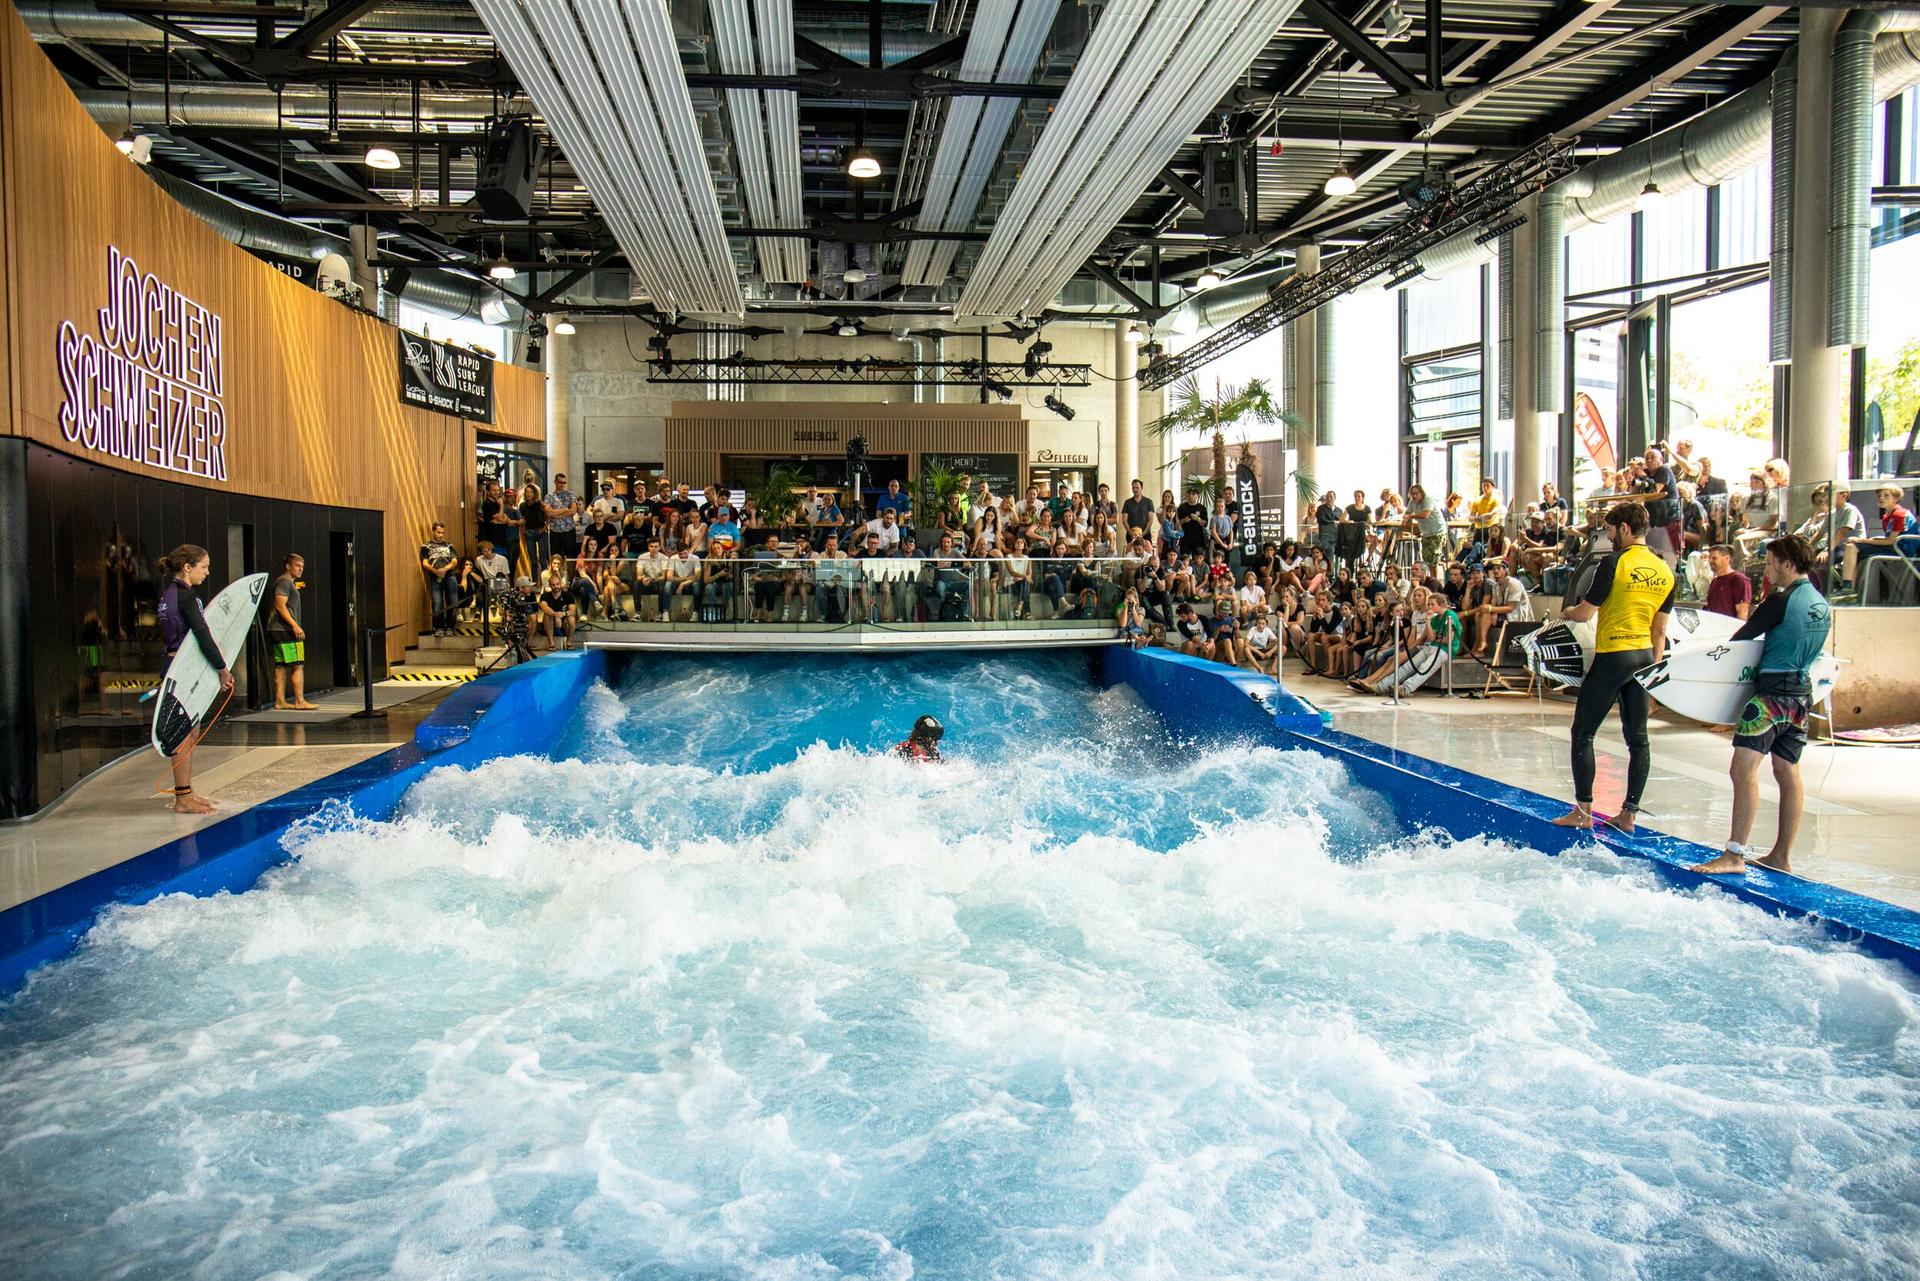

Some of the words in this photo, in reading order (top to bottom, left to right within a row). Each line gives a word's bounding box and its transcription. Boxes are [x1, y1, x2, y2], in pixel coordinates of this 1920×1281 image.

[97, 244, 223, 398] JOCHEN
[457, 354, 480, 371] RAPID
[457, 367, 477, 382] SURF
[458, 381, 486, 397] LEAGUE
[57, 319, 228, 482] SCHWEIZER
[428, 394, 454, 410] G-SHOCK
[1054, 454, 1088, 463] FLIEGEN
[1240, 479, 1257, 556] G-SHOCK
[1634, 566, 1668, 588] Pure
